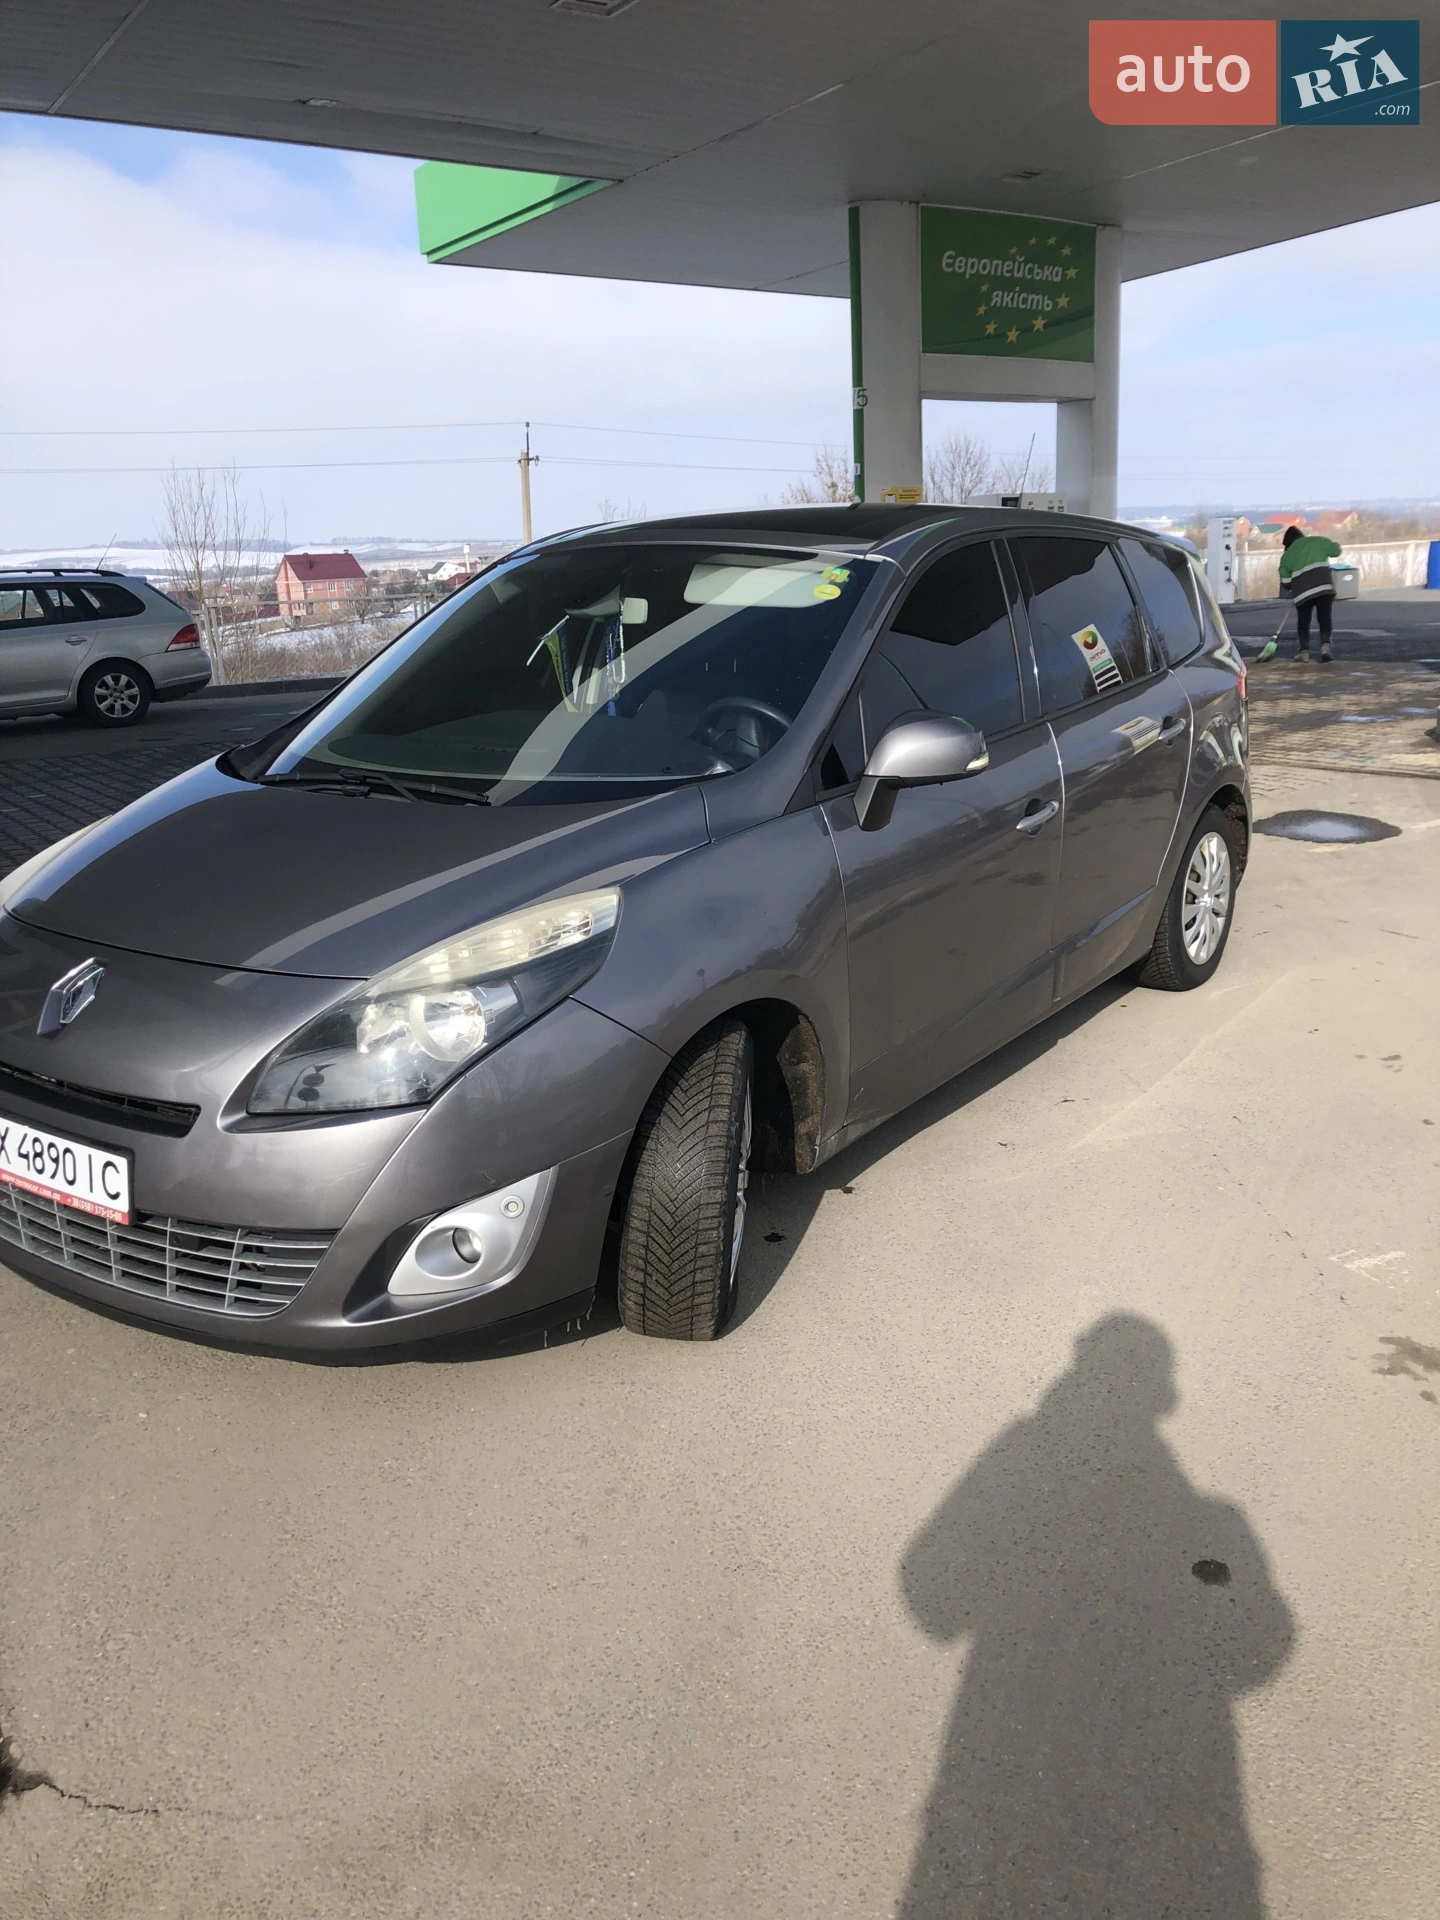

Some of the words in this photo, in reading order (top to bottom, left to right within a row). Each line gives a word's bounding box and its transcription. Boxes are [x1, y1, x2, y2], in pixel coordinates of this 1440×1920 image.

[942, 250, 1063, 283] Європейська
[990, 286, 1054, 311] якість
[856, 388, 869, 407] 5
[17, 1133, 77, 1187] 4890
[87, 1153, 121, 1201] IC
